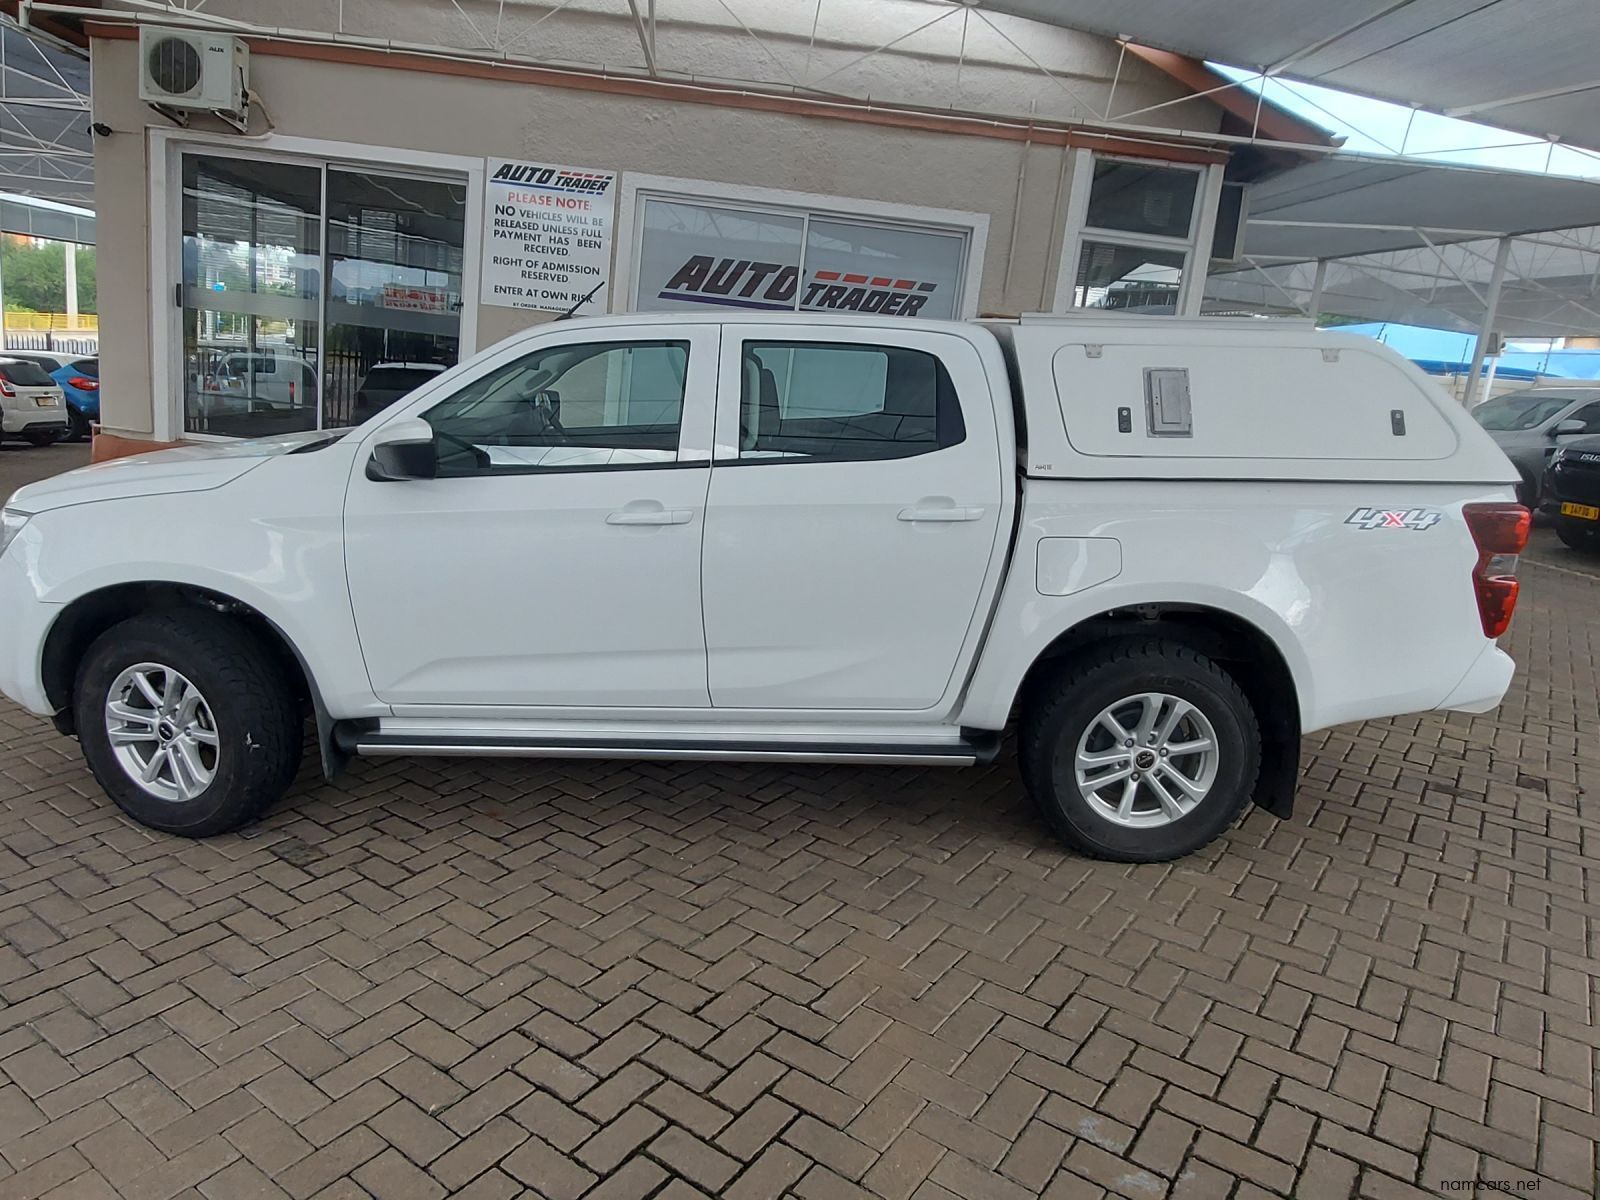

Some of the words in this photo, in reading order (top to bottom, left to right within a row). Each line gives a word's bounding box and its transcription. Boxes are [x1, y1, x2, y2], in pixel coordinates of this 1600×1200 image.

[493, 164, 556, 184] AUTO
[554, 175, 610, 192] TRADER
[508, 191, 552, 206] PLEASE
[556, 197, 593, 211] NOTE:
[495, 204, 516, 217] NO
[519, 209, 563, 222] VEHICLES
[566, 214, 588, 225] WILL
[592, 217, 603, 227] BE
[494, 218, 539, 231] RELEASED
[542, 224, 578, 236] UNLESS
[581, 228, 602, 239] FULL
[493, 229, 542, 243] PAYMENT
[549, 235, 570, 246] HAS
[577, 239, 602, 249] BEEN
[493, 256, 523, 267] RIGHT
[525, 259, 540, 269] OF
[542, 261, 600, 276] ADMISSION
[494, 285, 523, 296] ENTER
[526, 288, 539, 298] AT
[541, 290, 568, 301] OWN
[664, 255, 806, 301] AUTO
[800, 282, 929, 317] TRADER
